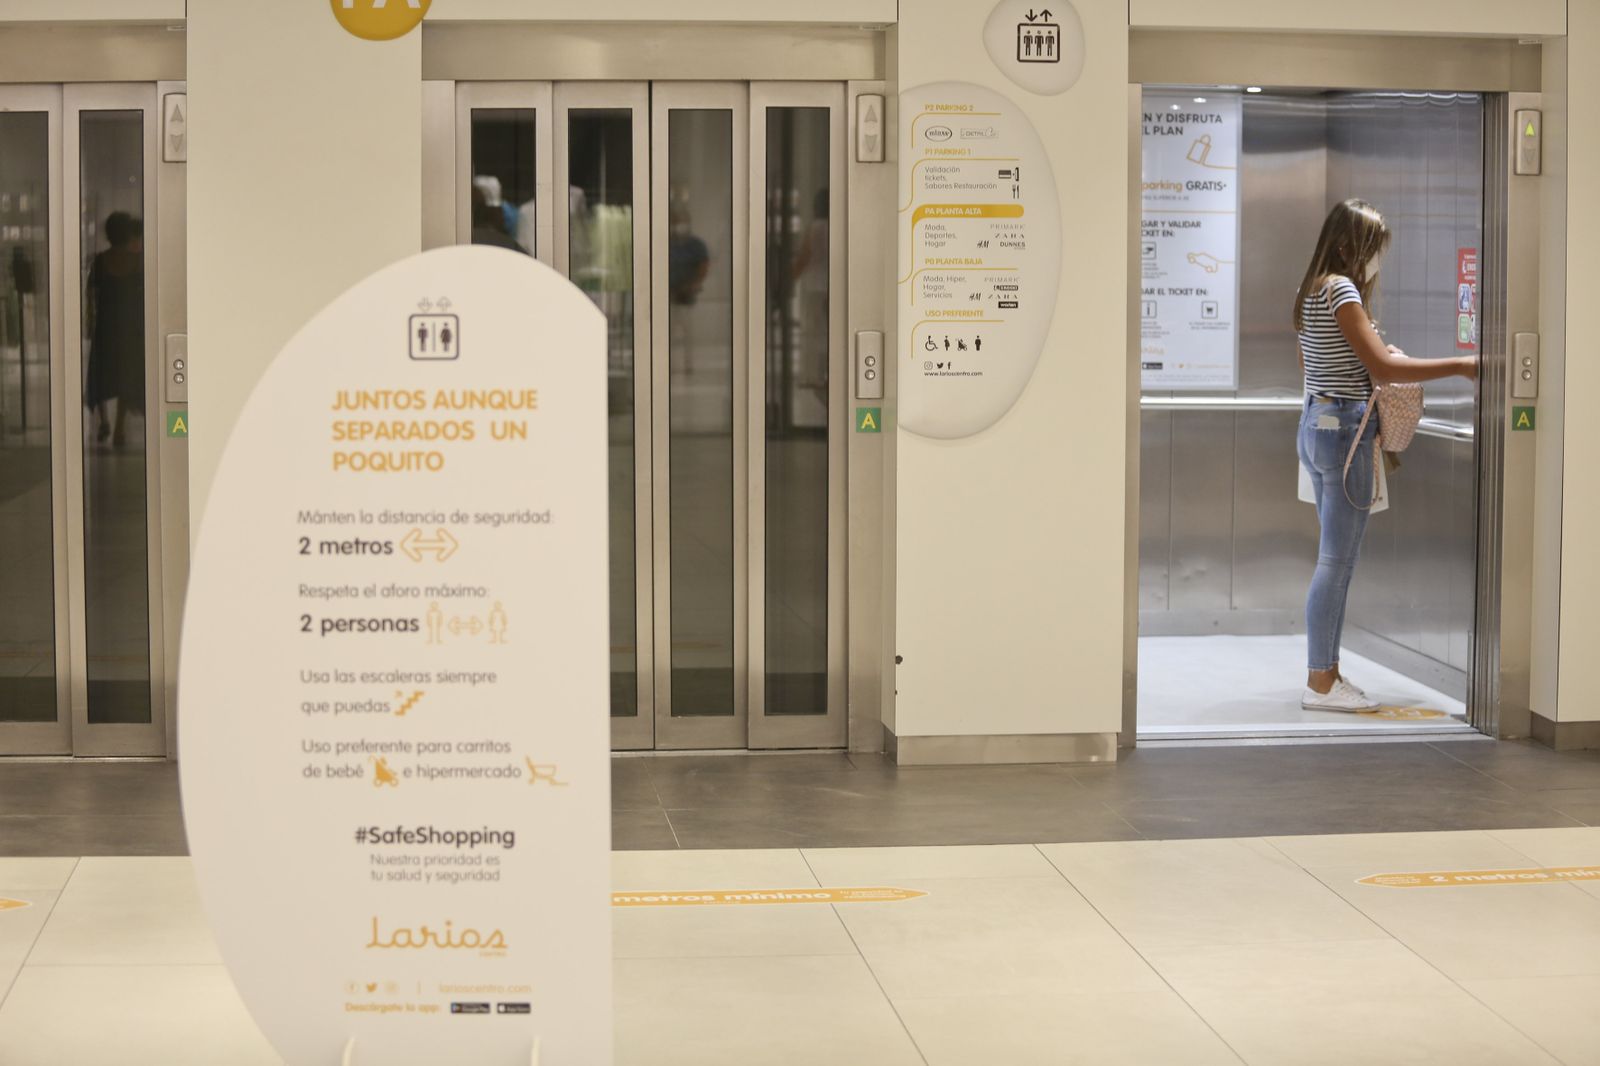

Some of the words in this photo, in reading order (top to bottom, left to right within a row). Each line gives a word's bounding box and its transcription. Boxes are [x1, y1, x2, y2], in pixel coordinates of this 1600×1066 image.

[924, 104, 934, 112] P2
[936, 104, 968, 112] PARKING
[969, 104, 974, 112] 2
[1142, 113, 1153, 122] N
[1155, 113, 1163, 122] Y
[1166, 113, 1223, 123] DISFRUTA
[1142, 126, 1151, 136] L
[1153, 126, 1184, 136] PLAN
[936, 148, 967, 156] PARKING
[924, 165, 961, 174] Validación
[954, 182, 998, 190] Restauración
[924, 207, 935, 215] PA
[936, 207, 963, 215] PLANTA
[964, 207, 982, 215] ALTA
[924, 223, 947, 232] Moda,
[1160, 220, 1166, 228] Y
[1168, 220, 1202, 229] VALIDAR
[1162, 229, 1175, 238] EN:
[924, 240, 947, 249] Hogar
[936, 257, 963, 265] PLANTA
[964, 257, 983, 265] BAJA
[1157, 287, 1166, 296] EL
[1168, 287, 1193, 296] TICKET
[1195, 287, 1208, 296] EN:
[924, 309, 940, 317] USO
[942, 309, 984, 317] PREFERENTE
[331, 389, 426, 411] JUNTOS
[433, 388, 538, 411] AUNQUE
[172, 415, 187, 433] A
[861, 412, 876, 429] A
[1516, 410, 1530, 427] A
[331, 420, 475, 441] SEPARADOS
[490, 420, 528, 441] UN
[332, 451, 445, 472] POQUITO
[297, 509, 356, 525] Mánten
[360, 509, 374, 525] la
[378, 509, 446, 525] distancia
[450, 509, 469, 525] de
[474, 509, 554, 528] seguridad:
[298, 537, 311, 555] 2
[319, 537, 394, 555] metros
[298, 584, 360, 601] Respeta
[363, 584, 377, 598] el
[381, 583, 420, 598] aforo
[424, 583, 490, 598] máximo:
[300, 614, 313, 633] 2
[321, 616, 420, 637] personas
[300, 669, 331, 684] Usa
[334, 669, 356, 684] las
[360, 669, 432, 684] escaleras
[436, 669, 498, 687] siempre
[301, 699, 330, 715] que
[334, 698, 391, 715] puedas
[301, 739, 331, 753] Uso
[335, 739, 413, 757] preferente
[416, 741, 451, 757] para
[456, 739, 511, 754] carritos
[302, 765, 322, 778] de
[326, 764, 364, 778] bebé
[402, 768, 413, 778] e
[416, 764, 522, 782] hipermercado
[355, 826, 515, 849] #SafeShopping
[370, 854, 421, 866] Nuestra
[424, 853, 482, 868] prioridad
[485, 857, 501, 866] es
[370, 870, 383, 882] tu
[386, 870, 422, 882] salud
[425, 873, 433, 884] y
[435, 870, 501, 884] seguridad
[1428, 874, 1449, 883] 2
[1455, 872, 1549, 882] metros
[612, 894, 715, 902] metros
[724, 890, 832, 900] mínimo
[406, 1002, 415, 1012] la
